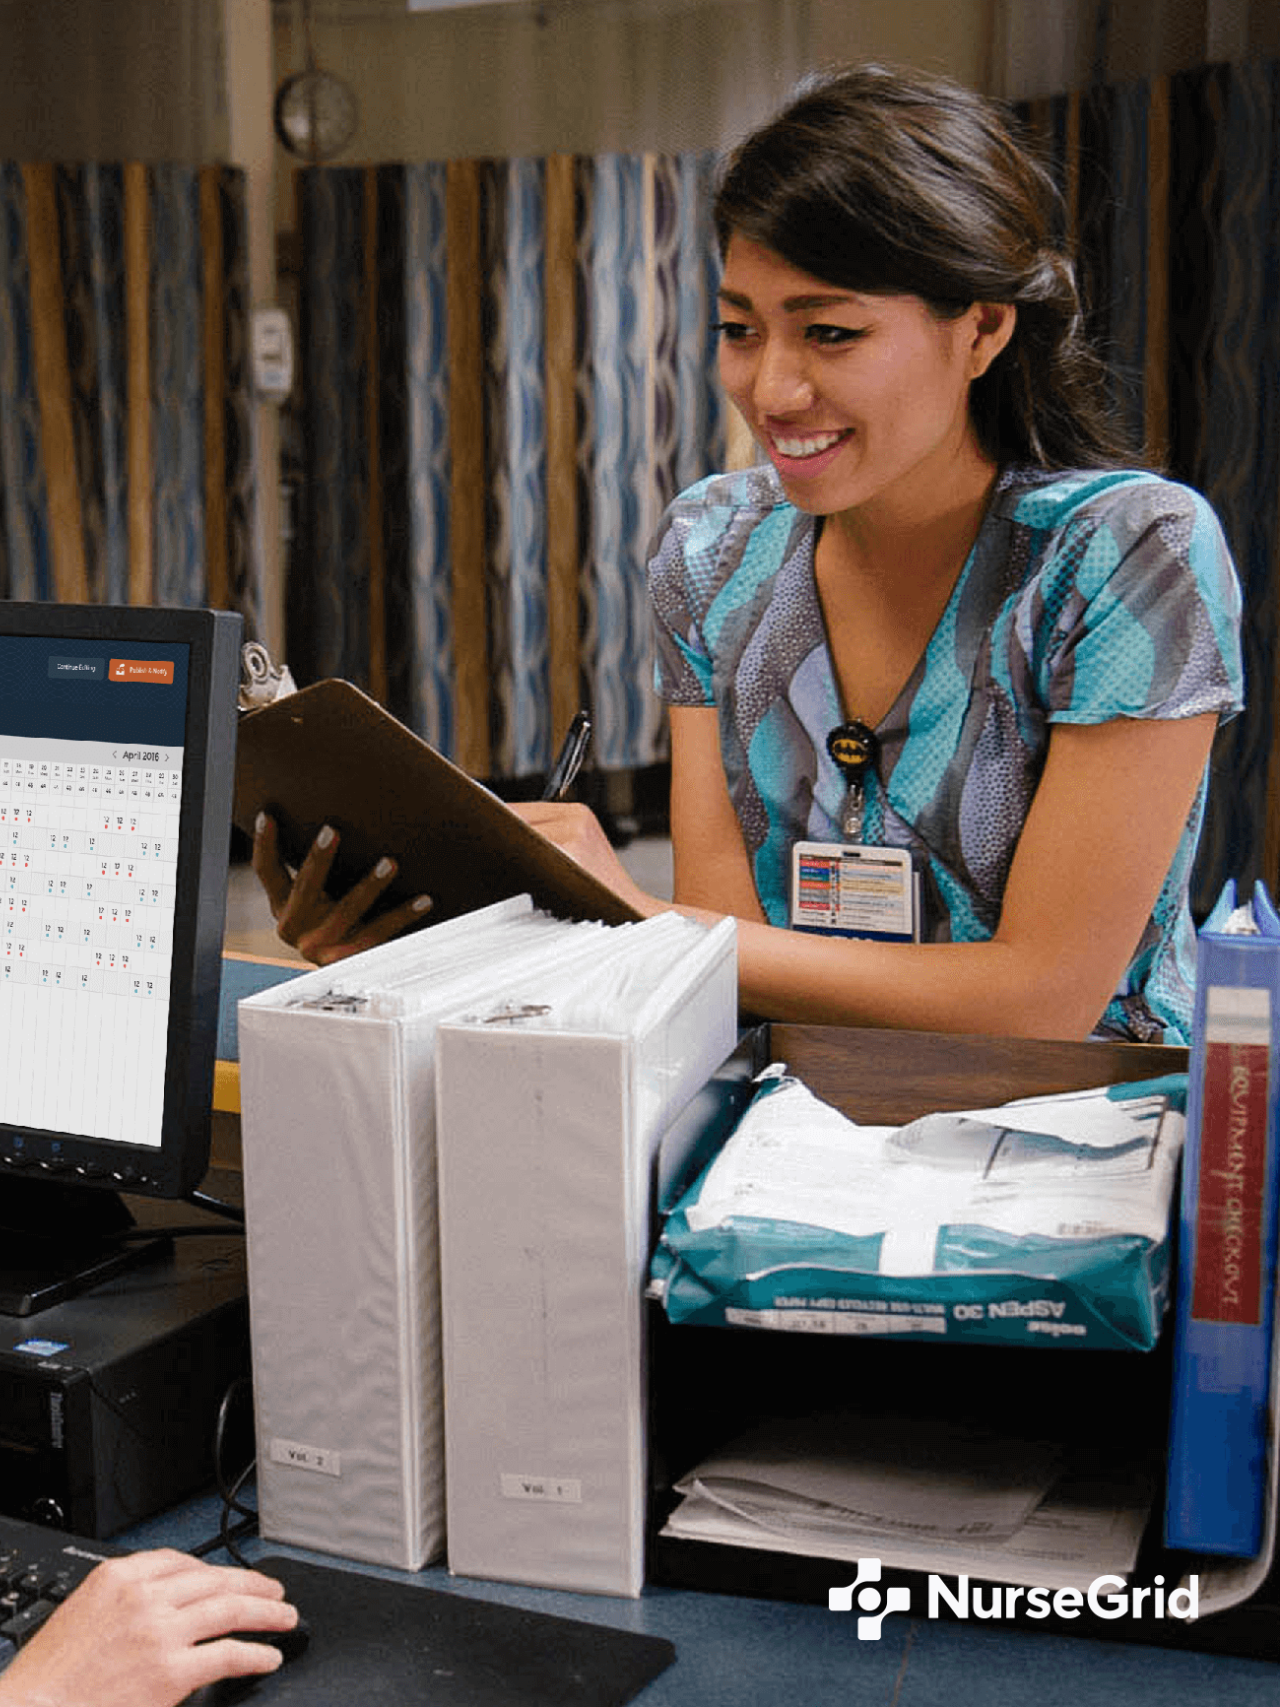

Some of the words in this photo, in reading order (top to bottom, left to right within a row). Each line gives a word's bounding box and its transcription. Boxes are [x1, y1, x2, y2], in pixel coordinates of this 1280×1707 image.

[122, 750, 141, 762] April
[142, 751, 160, 762] 2016
[953, 1303, 984, 1320] 30
[987, 1299, 1066, 1320] ASPEN
